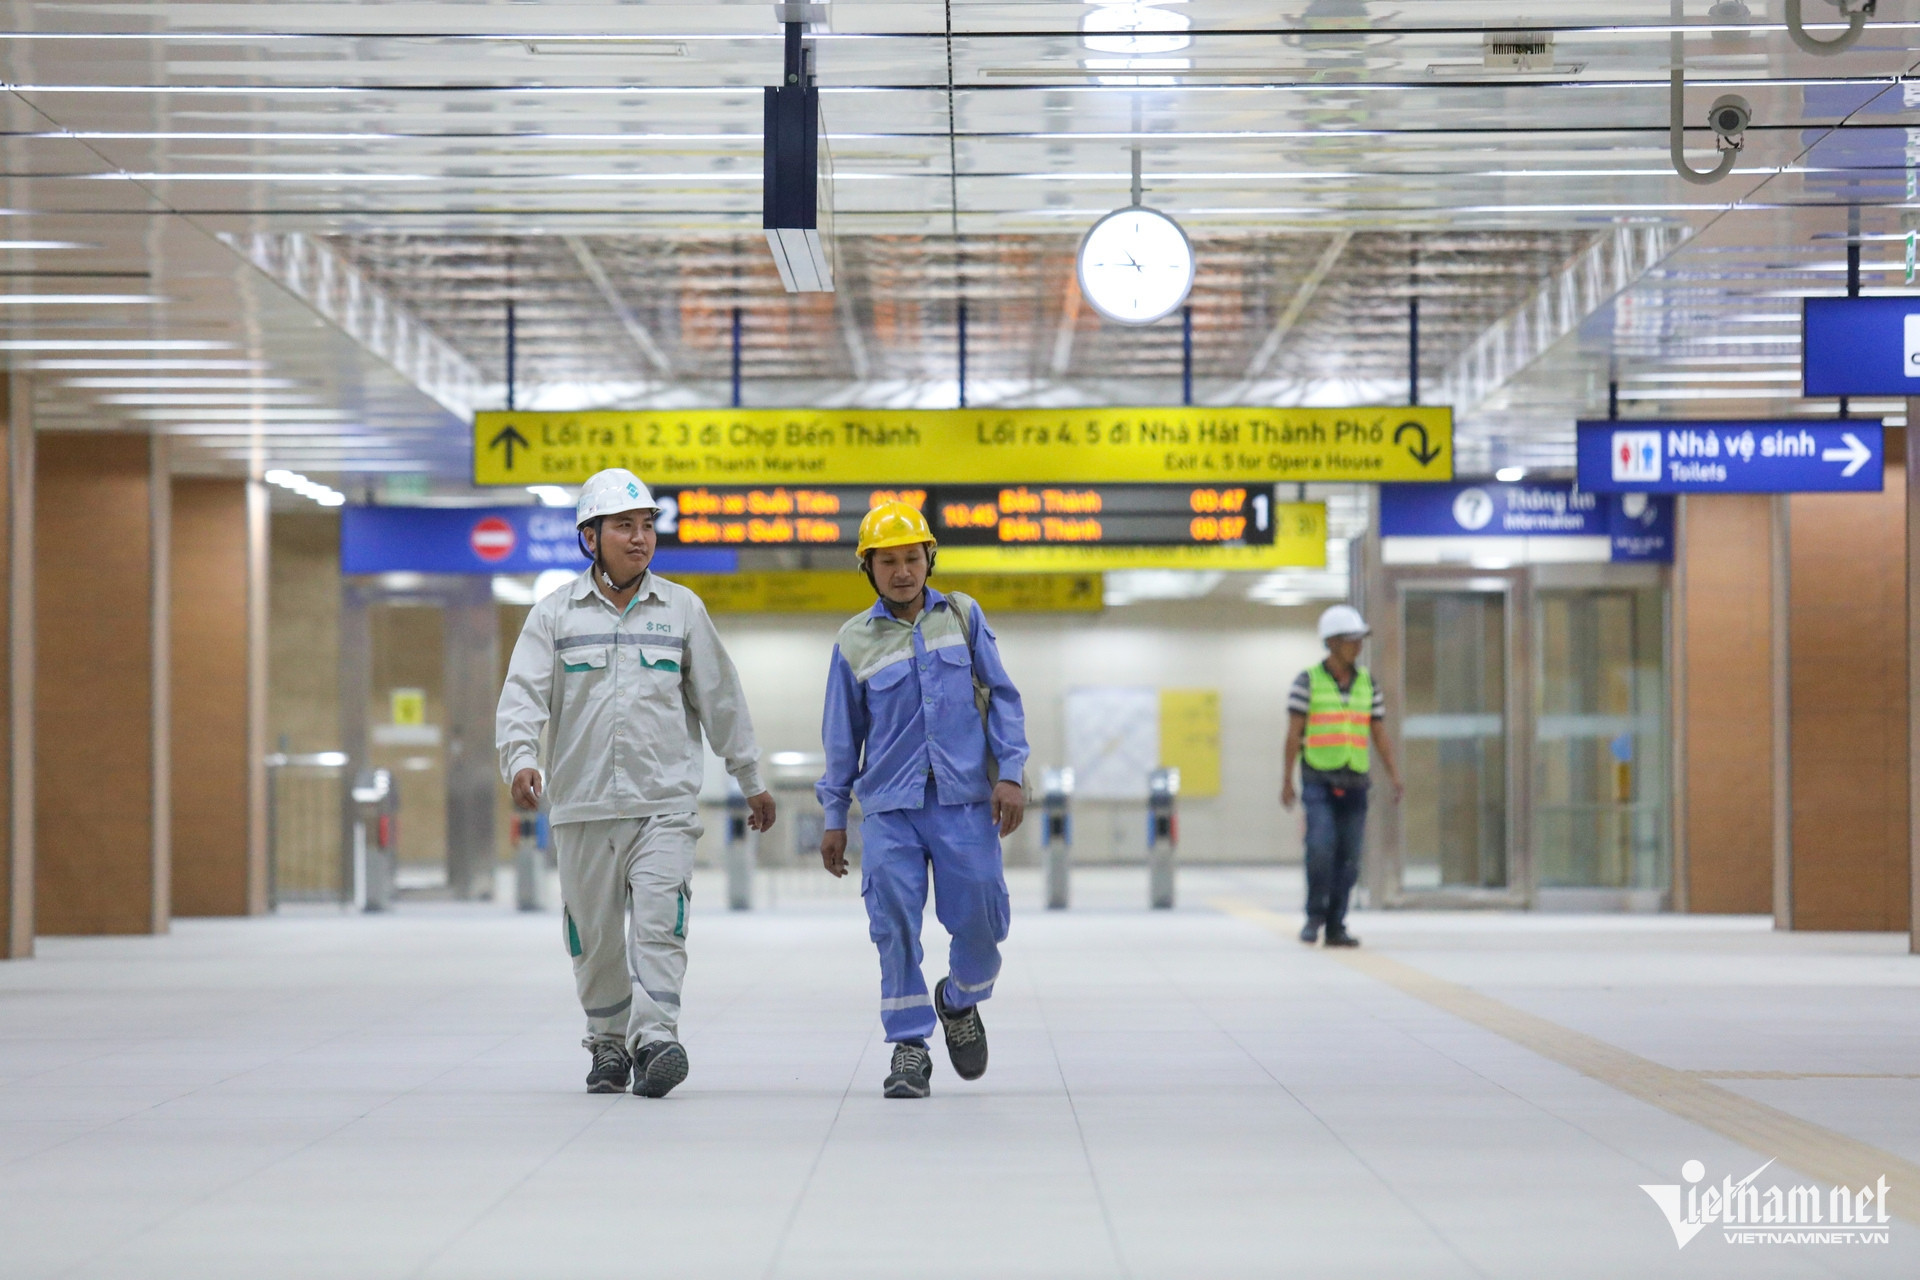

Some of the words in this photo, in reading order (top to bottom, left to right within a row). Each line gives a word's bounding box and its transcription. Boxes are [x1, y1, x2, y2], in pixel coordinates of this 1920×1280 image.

[541, 419, 581, 446] Lối
[588, 427, 615, 446] ra
[676, 422, 691, 446] 3
[729, 421, 778, 450] Chợ
[785, 419, 835, 446] Bến
[843, 421, 921, 446] Thành
[976, 419, 1016, 445] Lối
[1022, 426, 1049, 445] ra
[1085, 421, 1101, 444] 5
[1109, 421, 1131, 445] đi
[1139, 420, 1190, 444] Nhà
[1199, 420, 1240, 444] Hát
[1249, 420, 1327, 444] Thành
[1335, 415, 1384, 444] Phố
[1667, 429, 1720, 458] Nhà
[1724, 429, 1756, 463] vệ
[1760, 429, 1816, 458] sinh
[1237, 452, 1261, 471] for
[1267, 452, 1323, 473] Opera
[1327, 452, 1383, 471] House
[1668, 461, 1728, 482] Toilets
[654, 497, 679, 534] 2
[1252, 493, 1269, 532] 1
[655, 622, 672, 633] PC1
